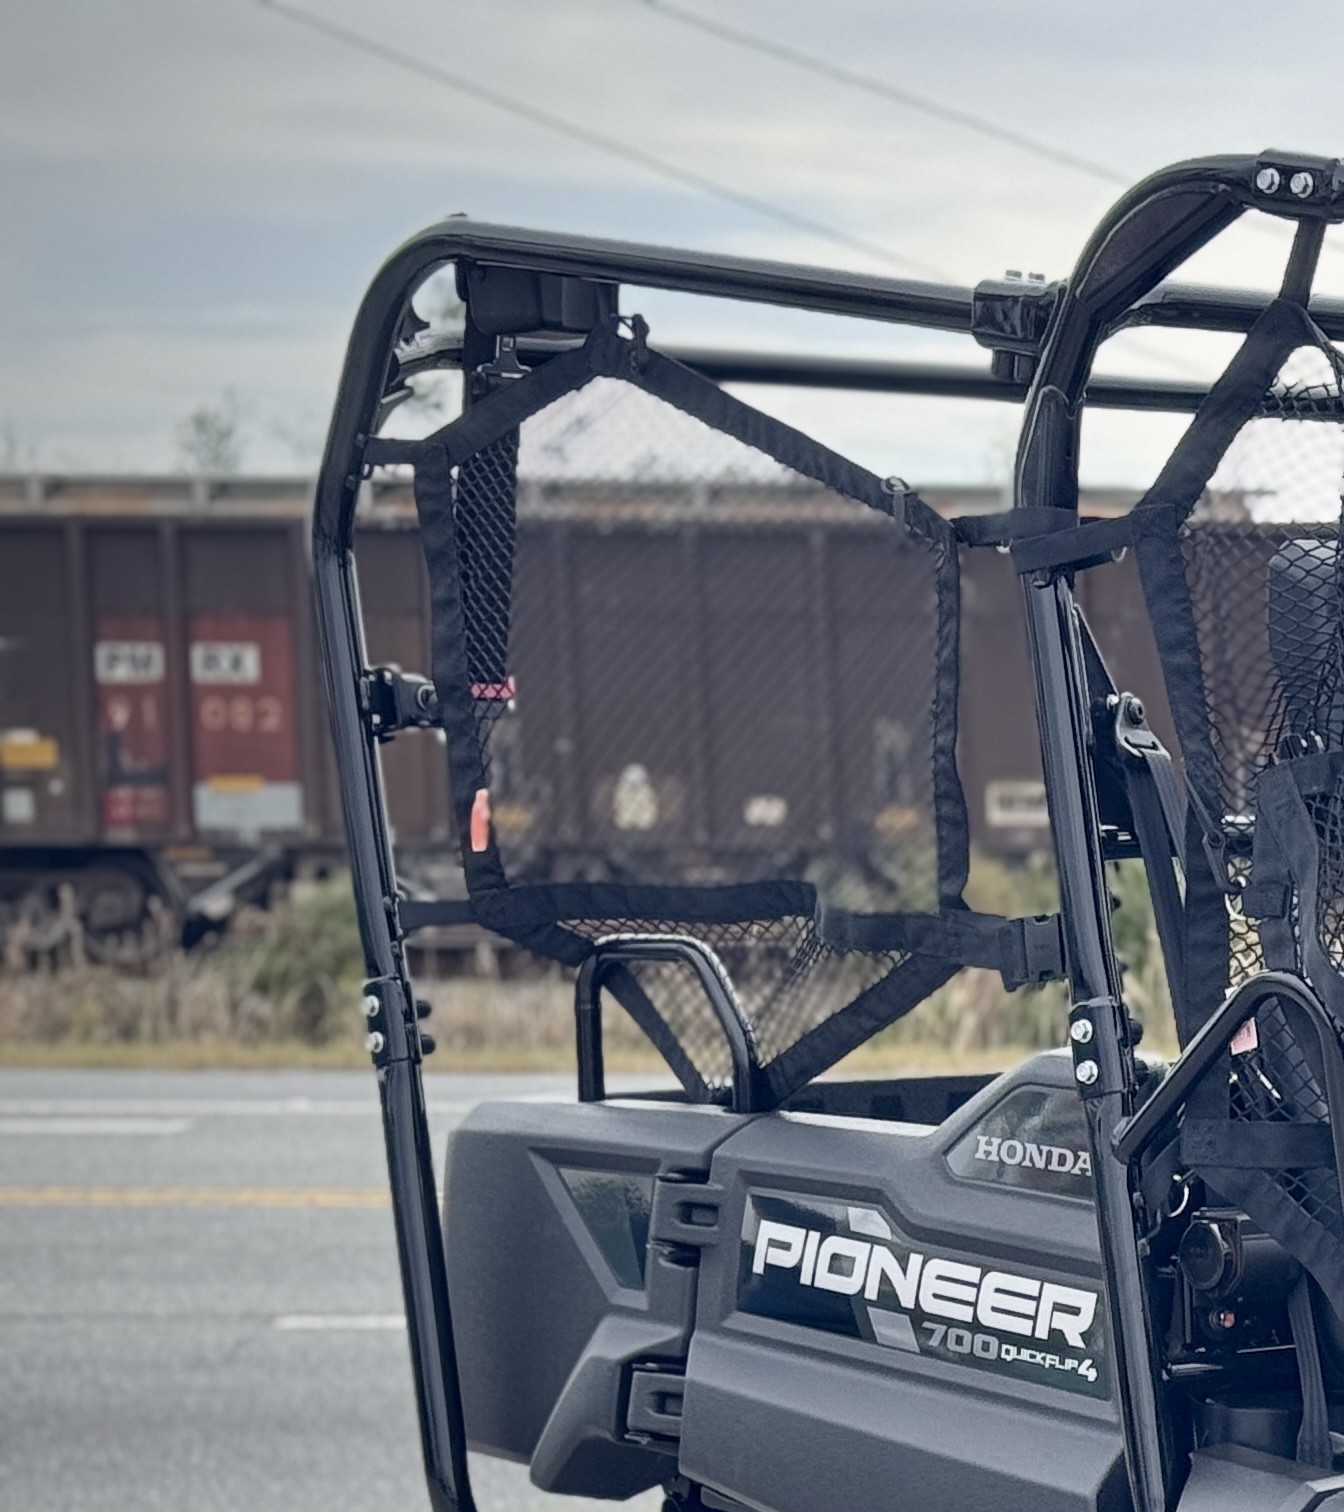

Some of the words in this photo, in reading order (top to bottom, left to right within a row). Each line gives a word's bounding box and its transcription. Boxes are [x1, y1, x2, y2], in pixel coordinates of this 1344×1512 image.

[974, 1134, 1093, 1177] HONDA
[752, 1220, 1098, 1349] PIONEER
[920, 1321, 1000, 1360] 700
